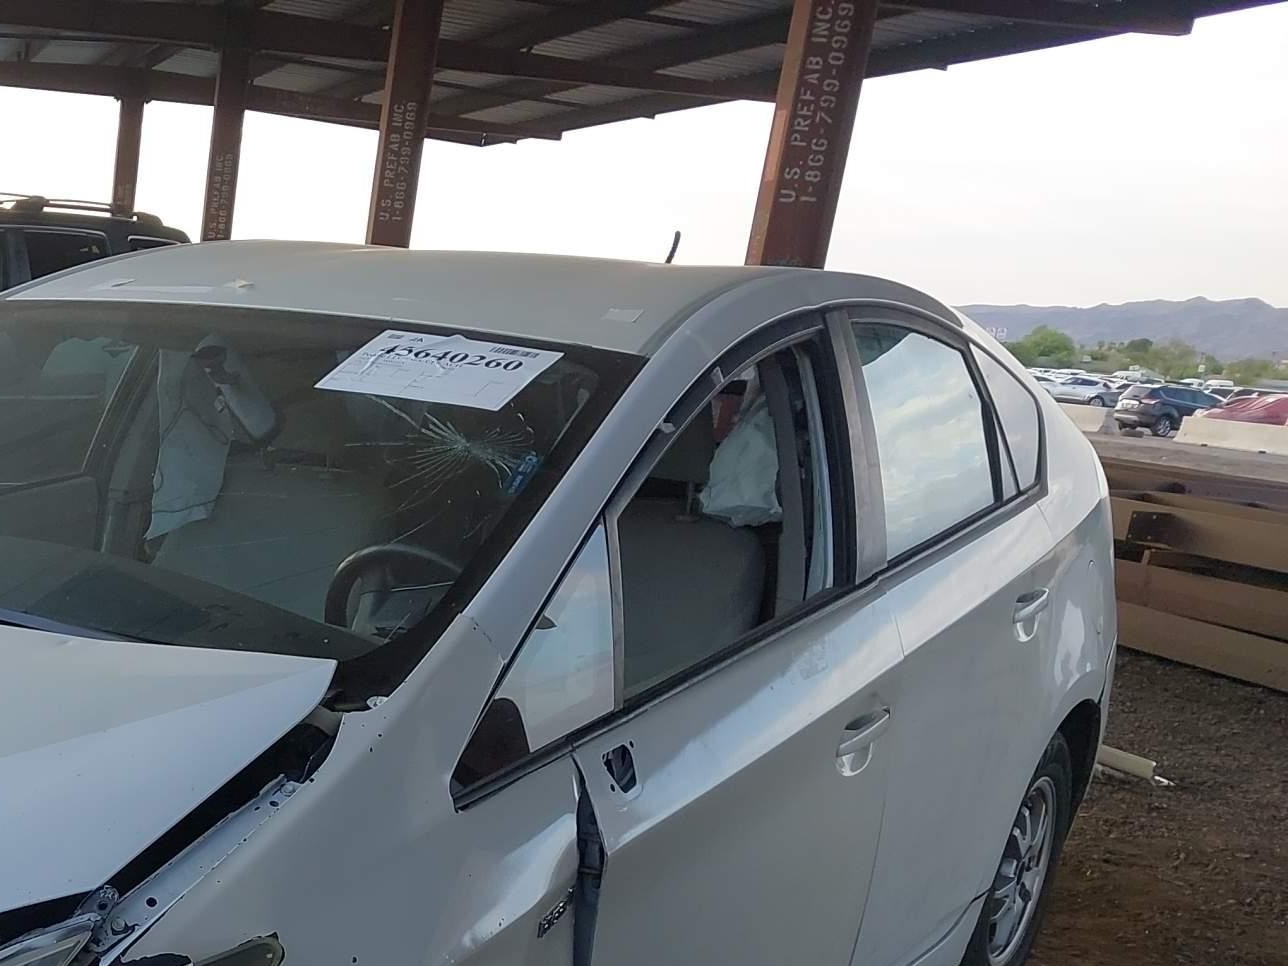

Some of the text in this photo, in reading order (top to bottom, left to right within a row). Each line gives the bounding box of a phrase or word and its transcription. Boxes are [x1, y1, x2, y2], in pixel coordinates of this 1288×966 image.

[790, 56, 823, 147] PREFAB
[383, 133, 401, 188] PREFAB
[779, 160, 803, 203] U.S.
[380, 344, 523, 371] 45640260
